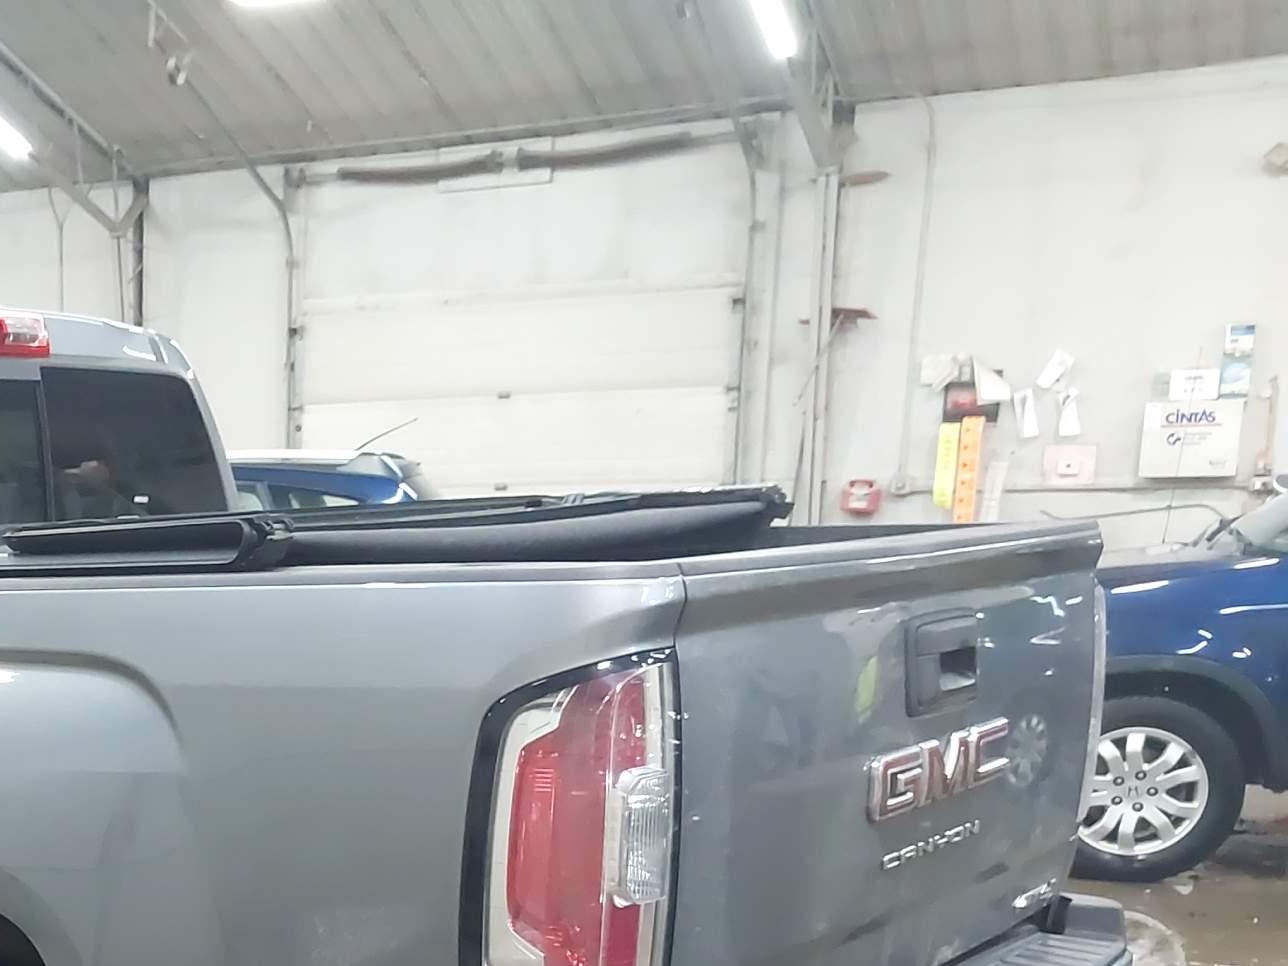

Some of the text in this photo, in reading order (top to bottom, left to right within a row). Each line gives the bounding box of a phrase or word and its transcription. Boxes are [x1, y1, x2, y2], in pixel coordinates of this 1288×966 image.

[1165, 408, 1216, 424] CINTAS
[866, 716, 1010, 822] GMC
[881, 819, 980, 870] CANYON
